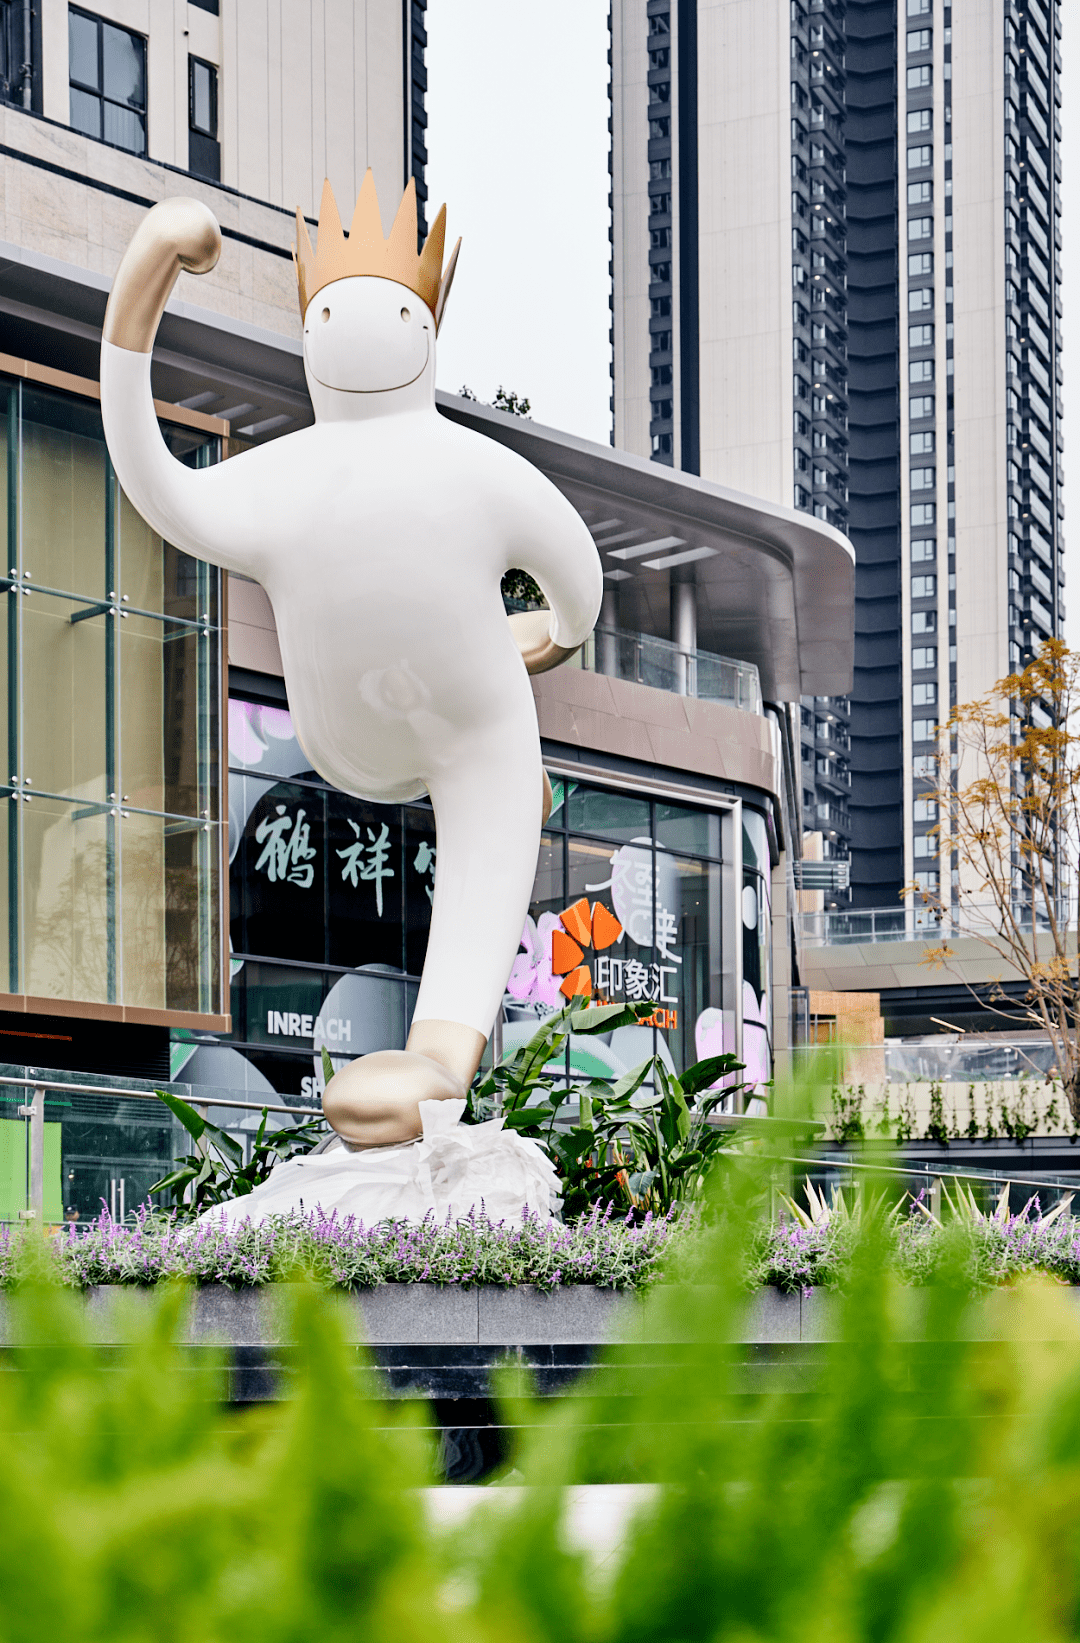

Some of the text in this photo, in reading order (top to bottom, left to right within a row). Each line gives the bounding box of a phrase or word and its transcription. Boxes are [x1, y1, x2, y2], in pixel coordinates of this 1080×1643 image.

[595, 956, 679, 1003] 印象汇
[267, 1000, 352, 1042] INREACH
